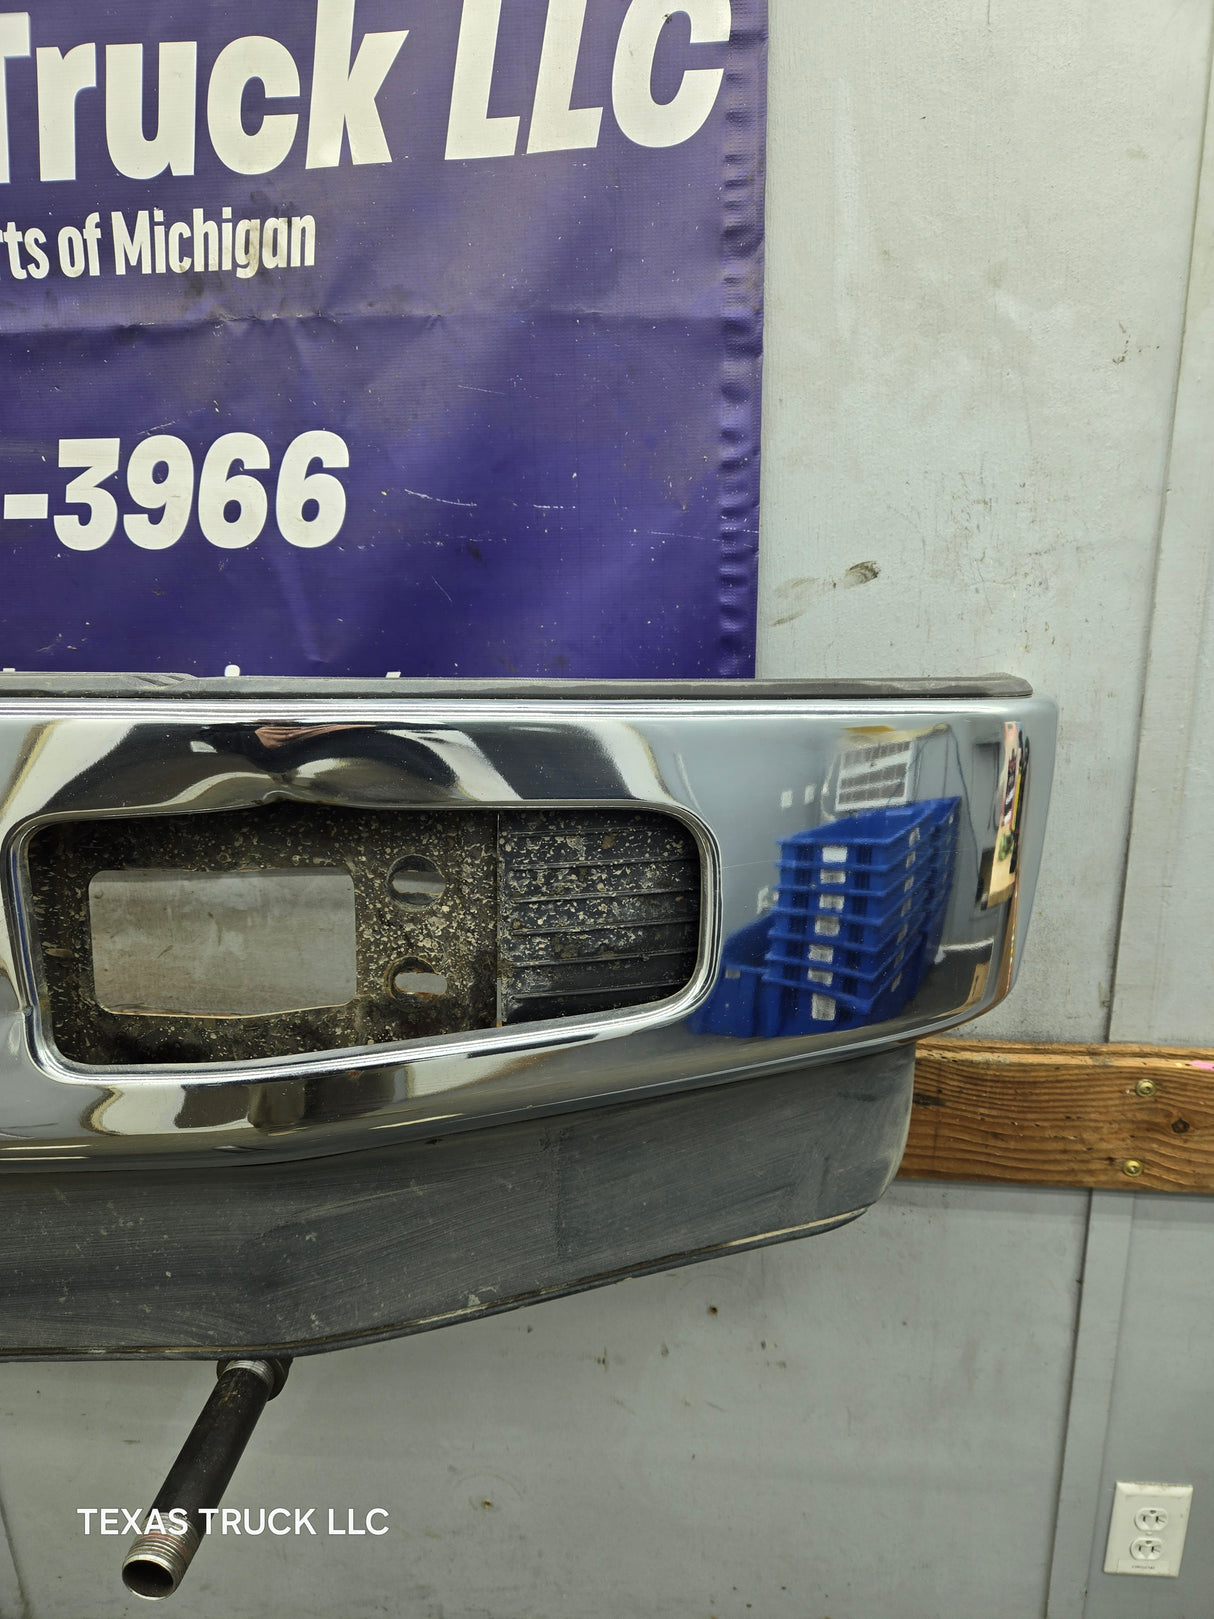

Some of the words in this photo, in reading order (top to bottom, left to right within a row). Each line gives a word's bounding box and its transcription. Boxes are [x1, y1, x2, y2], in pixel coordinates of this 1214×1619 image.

[444, 0, 732, 161] LLC
[0, 221, 50, 280] ts
[57, 211, 102, 278] of
[111, 207, 317, 279] Michigan
